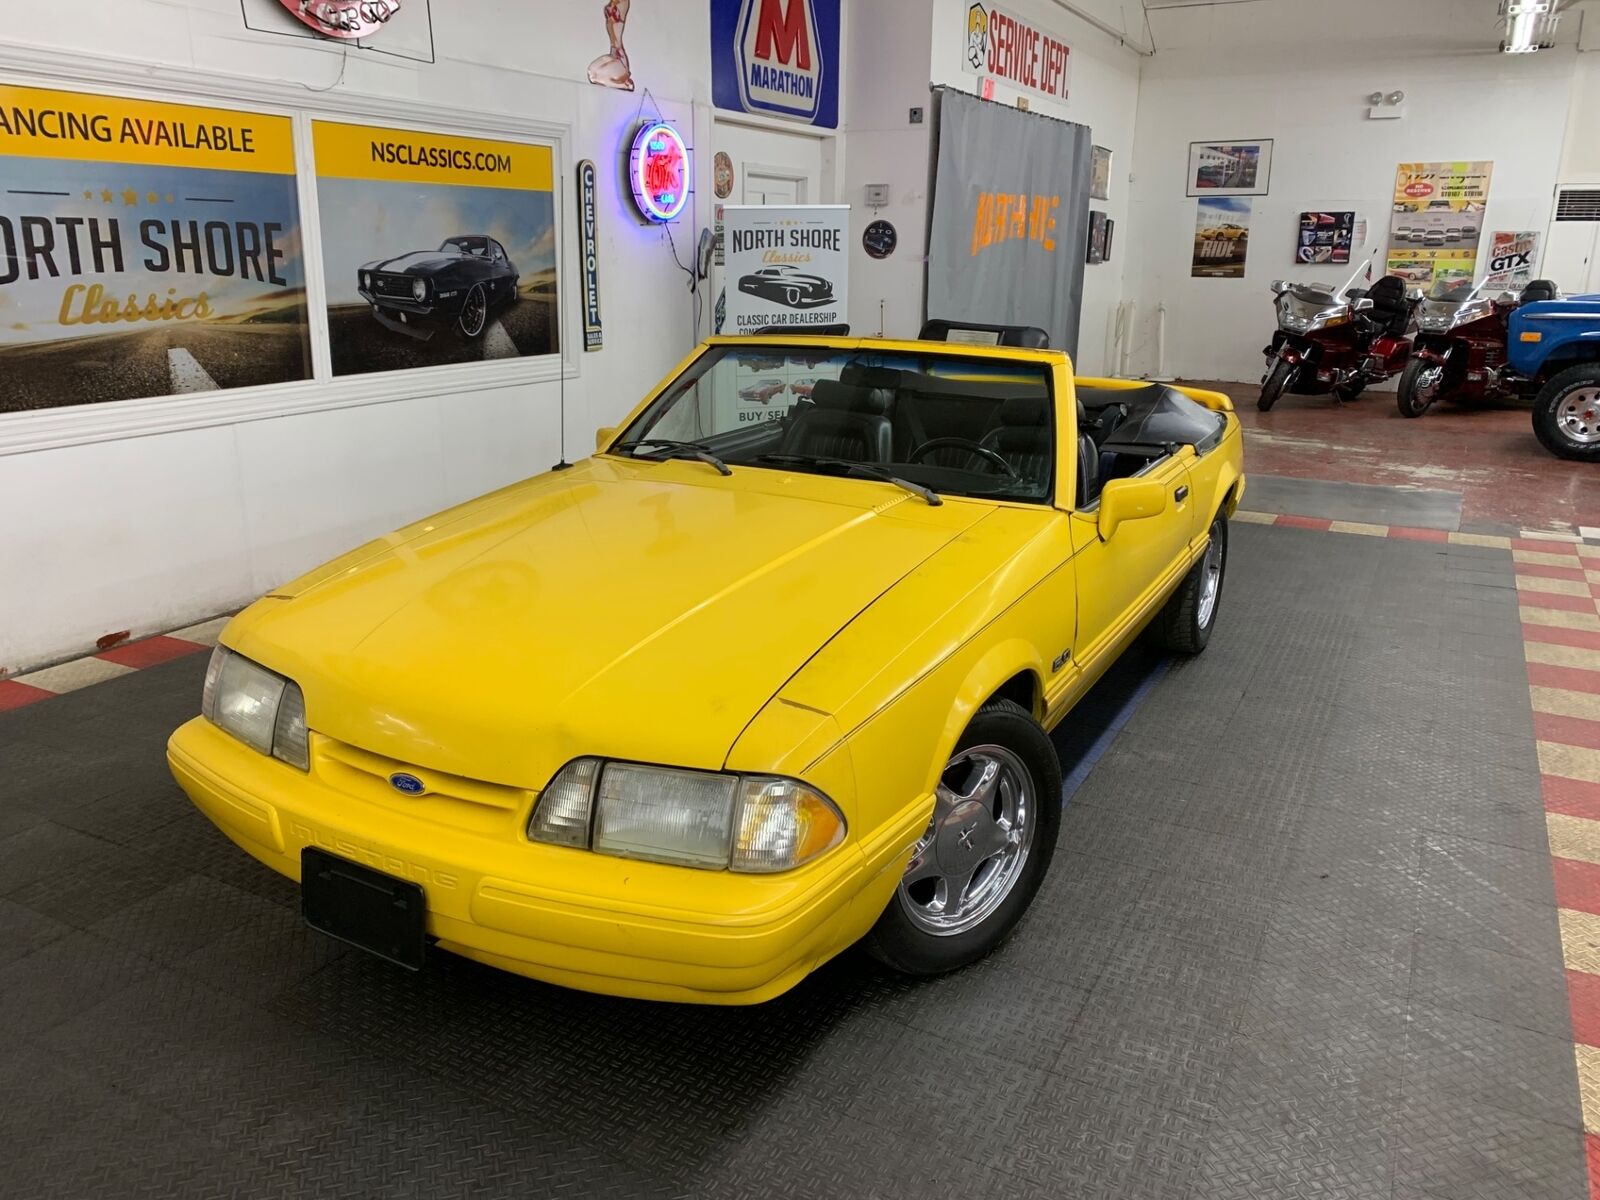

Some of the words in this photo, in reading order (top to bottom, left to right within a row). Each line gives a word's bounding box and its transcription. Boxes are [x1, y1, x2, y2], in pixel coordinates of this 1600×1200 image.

[987, 9, 1040, 88] SERVICE
[1040, 35, 1070, 100] DEPT.
[751, 63, 813, 98] MARATHON
[119, 117, 256, 153] AVAILABLE
[371, 141, 512, 173] NSCLASSICS.COM
[139, 219, 287, 287] SHORE
[584, 170, 597, 322] CHEVROLET
[733, 229, 785, 254] NORTH
[790, 229, 841, 252] SHORE
[762, 250, 811, 263] Classics
[1200, 240, 1236, 257] RIDE
[1490, 250, 1532, 272] GTX
[58, 282, 215, 326] Classics
[737, 314, 769, 326] CLASSIC
[771, 313, 787, 324] CAR
[789, 312, 837, 324] DEALERSHIP
